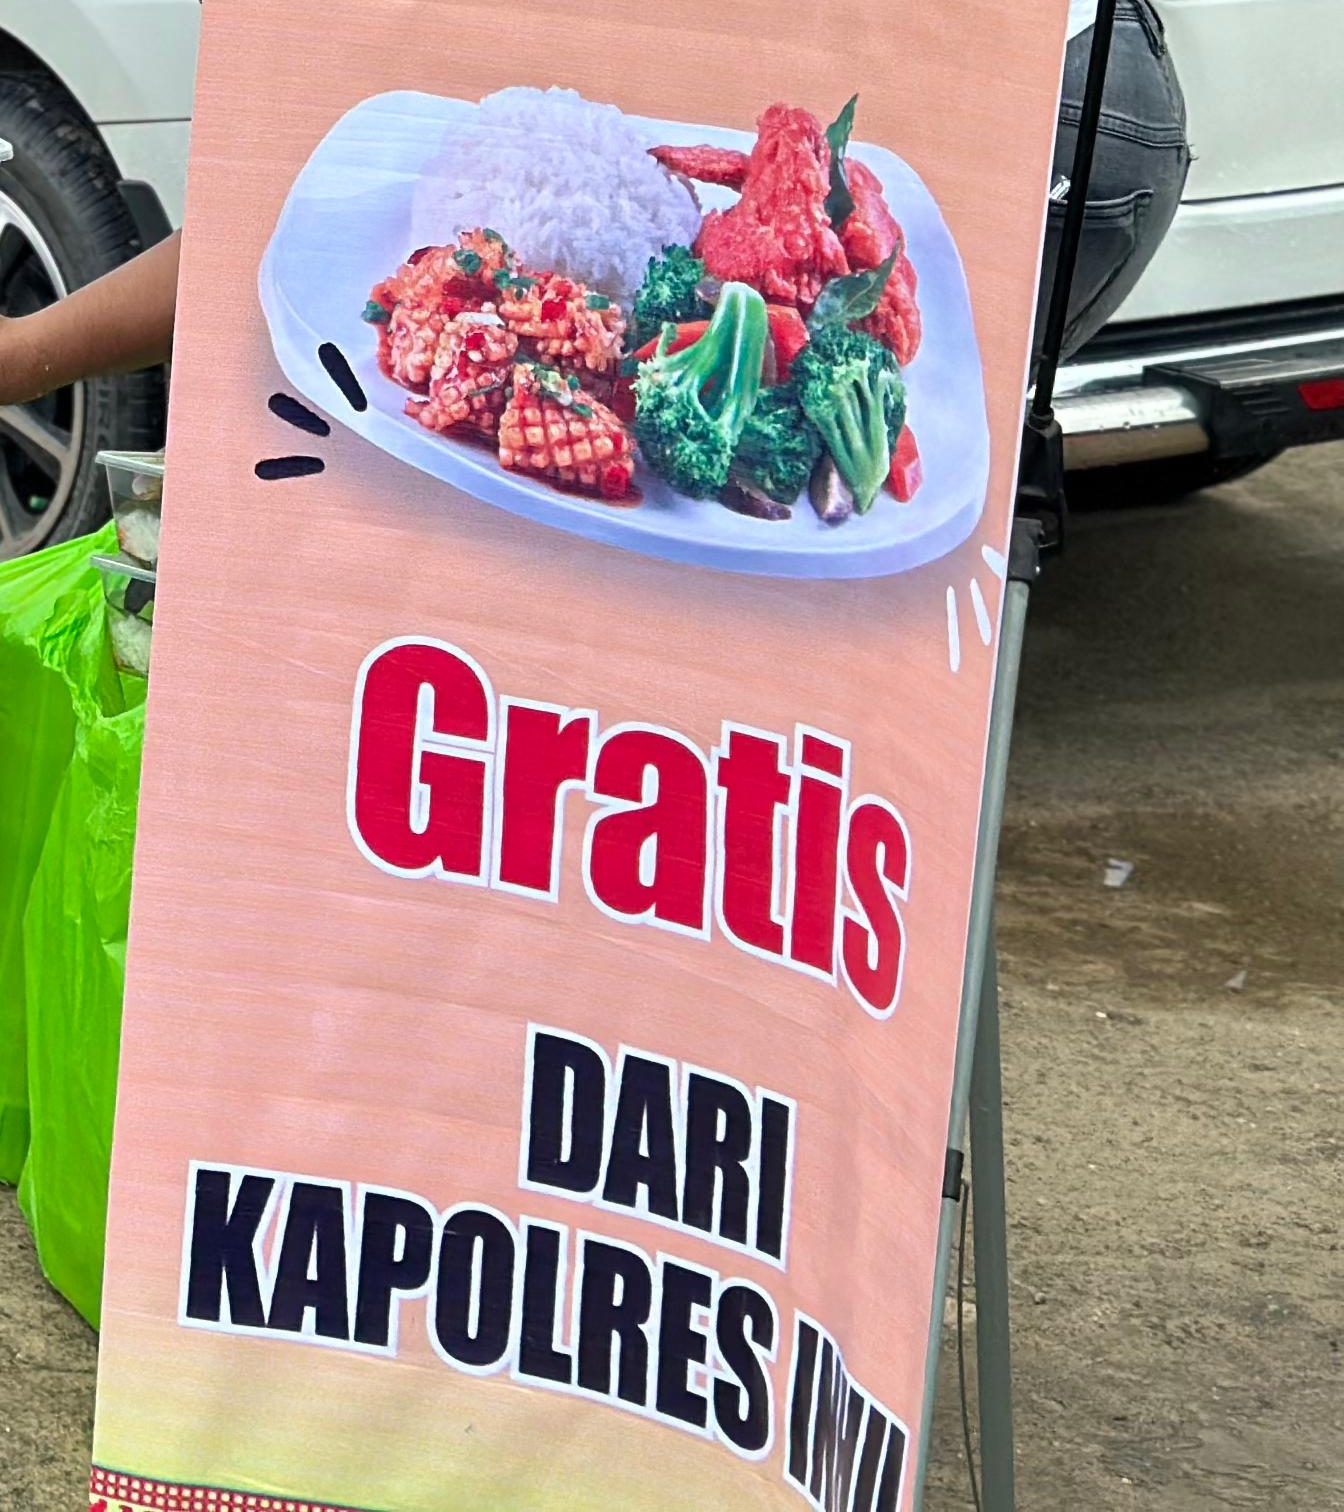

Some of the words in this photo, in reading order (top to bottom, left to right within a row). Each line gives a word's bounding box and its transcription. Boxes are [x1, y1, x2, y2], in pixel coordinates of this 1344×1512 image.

[353, 640, 907, 1014] Gratis
[524, 1030, 793, 1263] DARI
[184, 1166, 776, 1455] KAPOLRES
